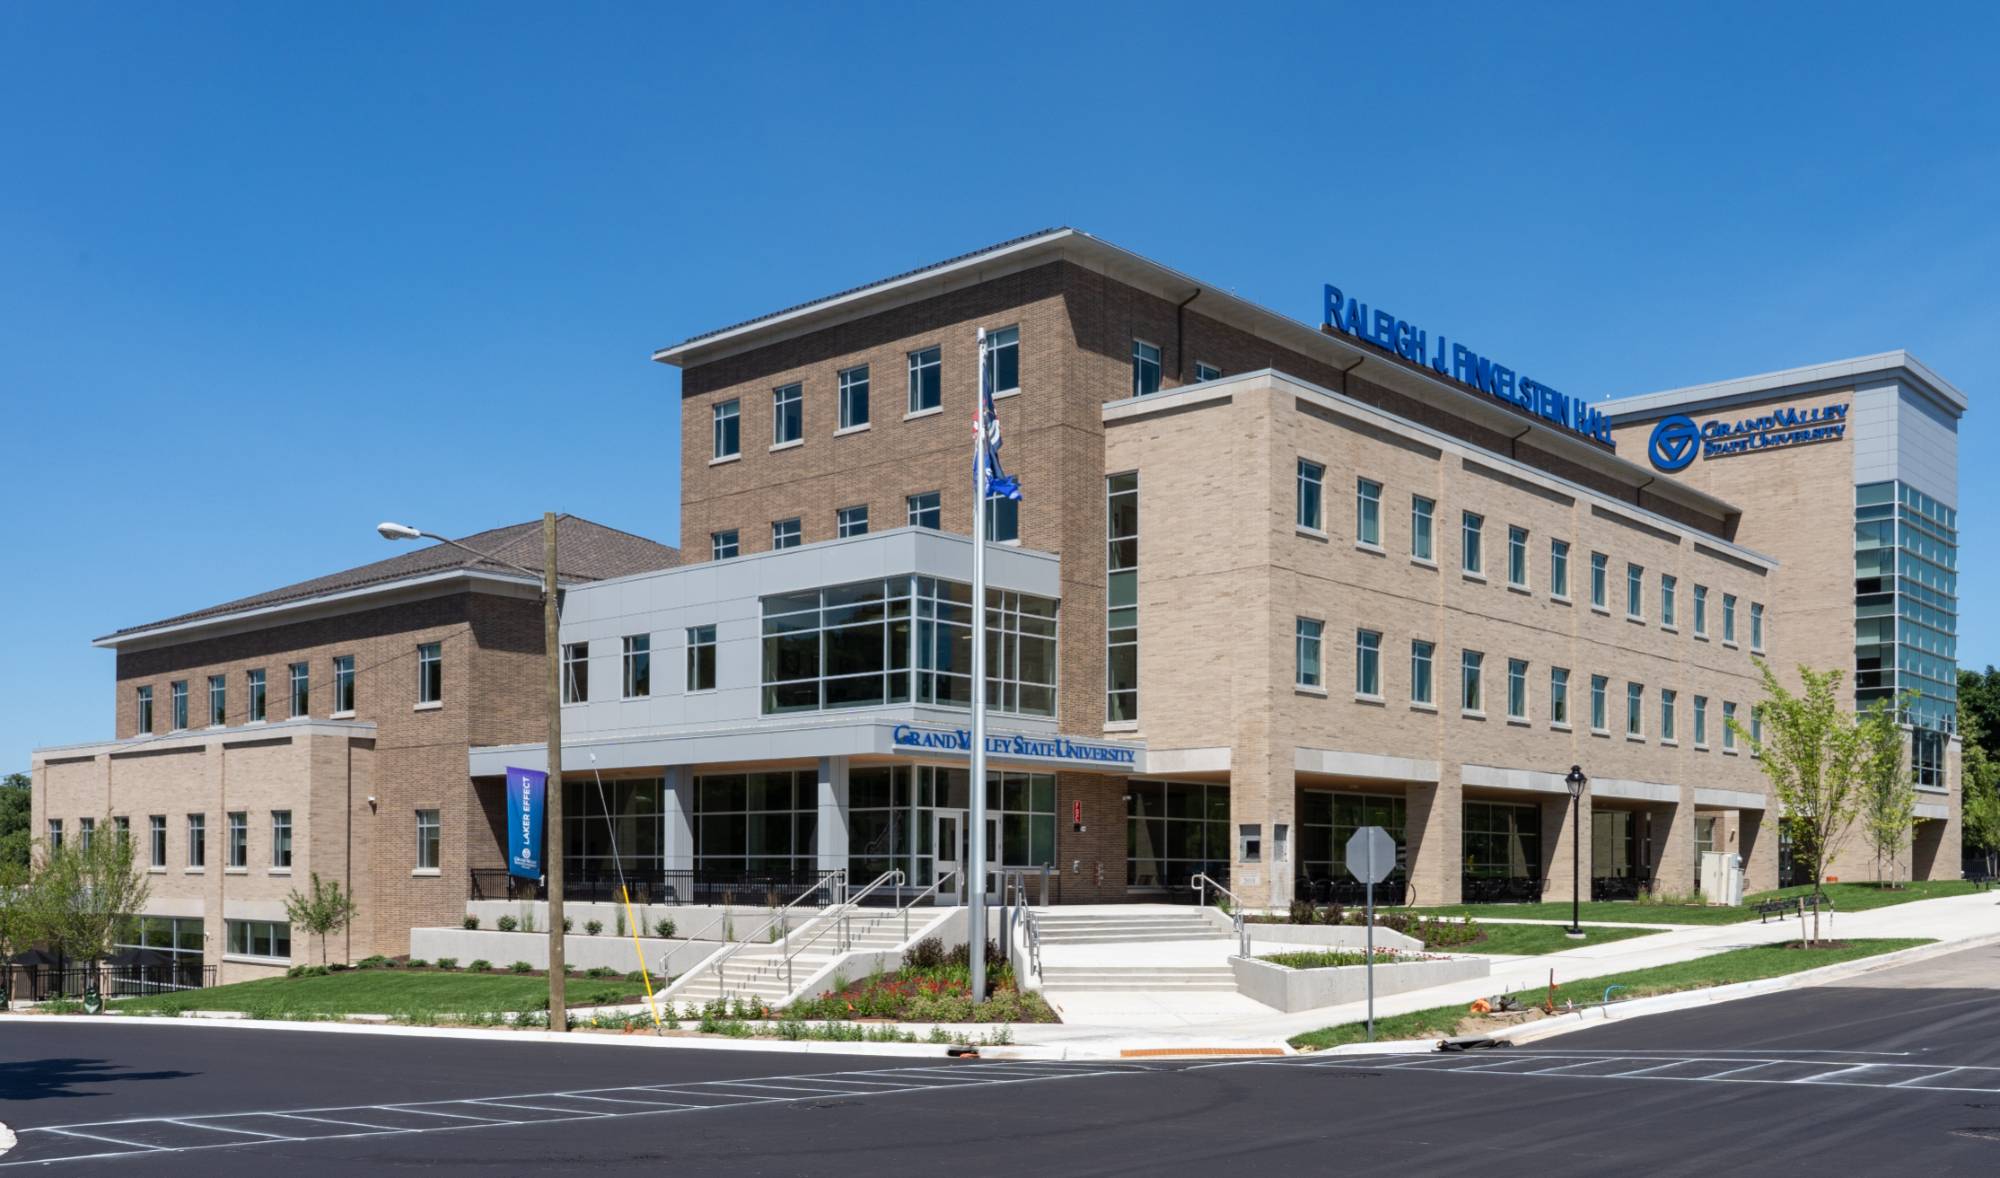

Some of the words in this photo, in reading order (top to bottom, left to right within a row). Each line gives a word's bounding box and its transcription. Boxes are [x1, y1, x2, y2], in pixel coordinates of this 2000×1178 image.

[1324, 283, 1426, 366] RALEIGH
[1432, 336, 1448, 374] J.
[1453, 342, 1570, 428] FINKELSTEIN
[1574, 398, 1616, 447] HALL
[1700, 417, 1774, 438] GRAND
[1773, 404, 1850, 427] VALLEY
[1703, 438, 1748, 456] STATE
[1748, 424, 1846, 449] UNIVERSITY
[894, 725, 957, 749] GRAND
[956, 729, 1011, 753] VLEY
[1013, 735, 1056, 757] STATE
[1055, 739, 1135, 763] UNIVERSITY
[522, 776, 531, 812] EFFECT
[522, 814, 531, 845] LAKER
